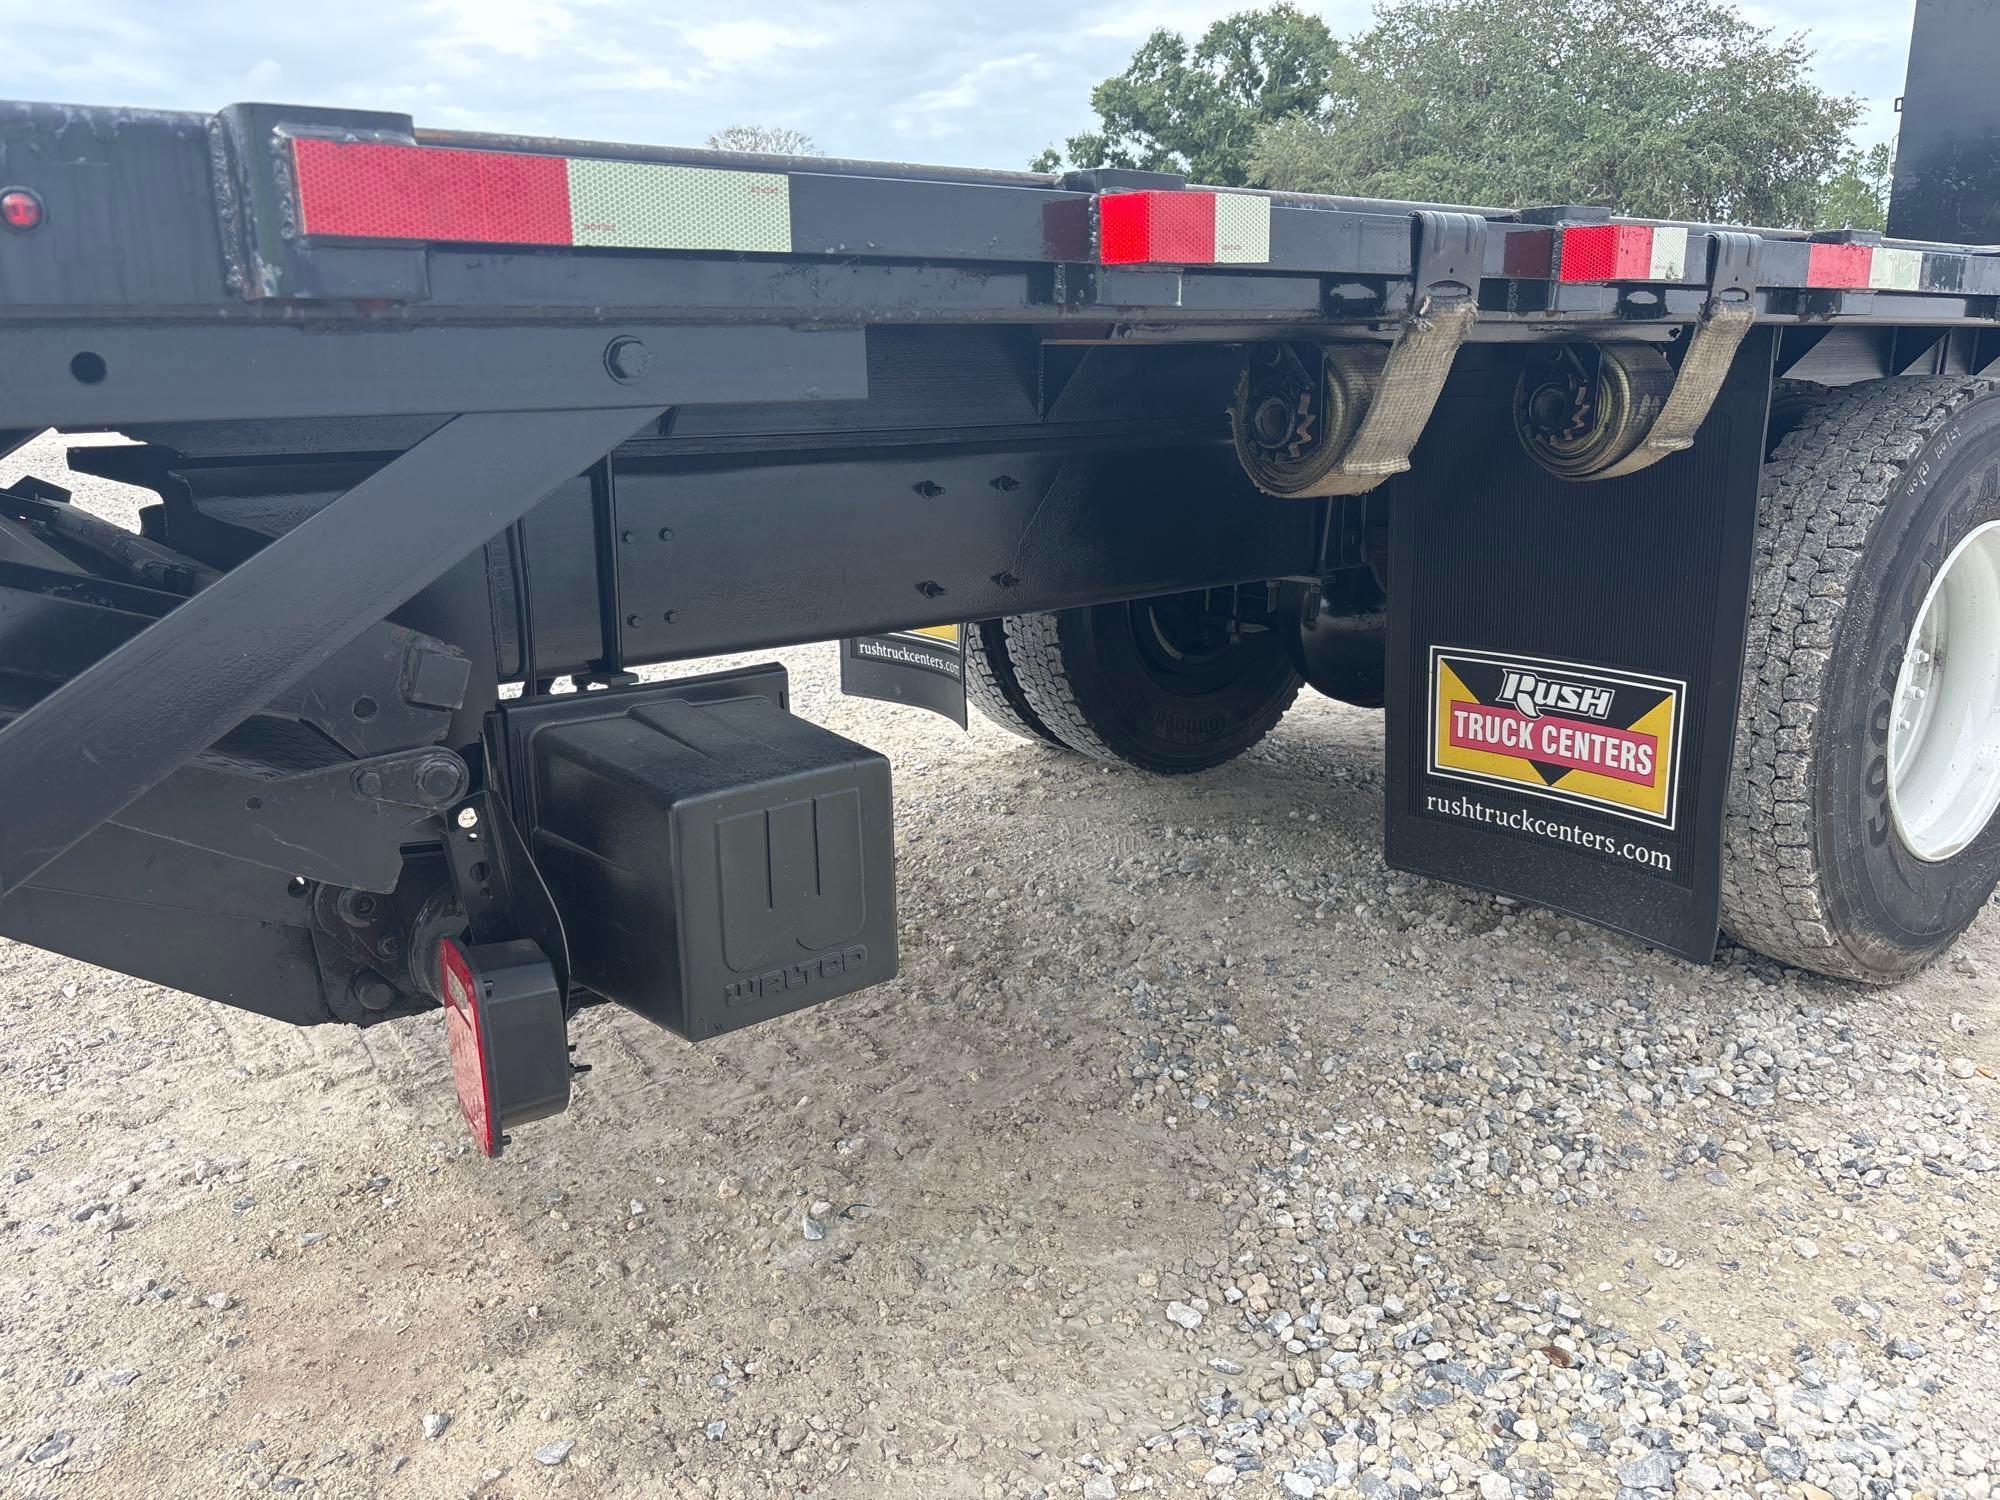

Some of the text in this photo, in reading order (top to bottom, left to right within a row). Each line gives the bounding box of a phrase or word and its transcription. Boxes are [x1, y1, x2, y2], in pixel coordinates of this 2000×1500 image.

[1453, 709, 1654, 776] TRUCK CENTERS
[1427, 795, 1673, 872] rushtruckcenters.com
